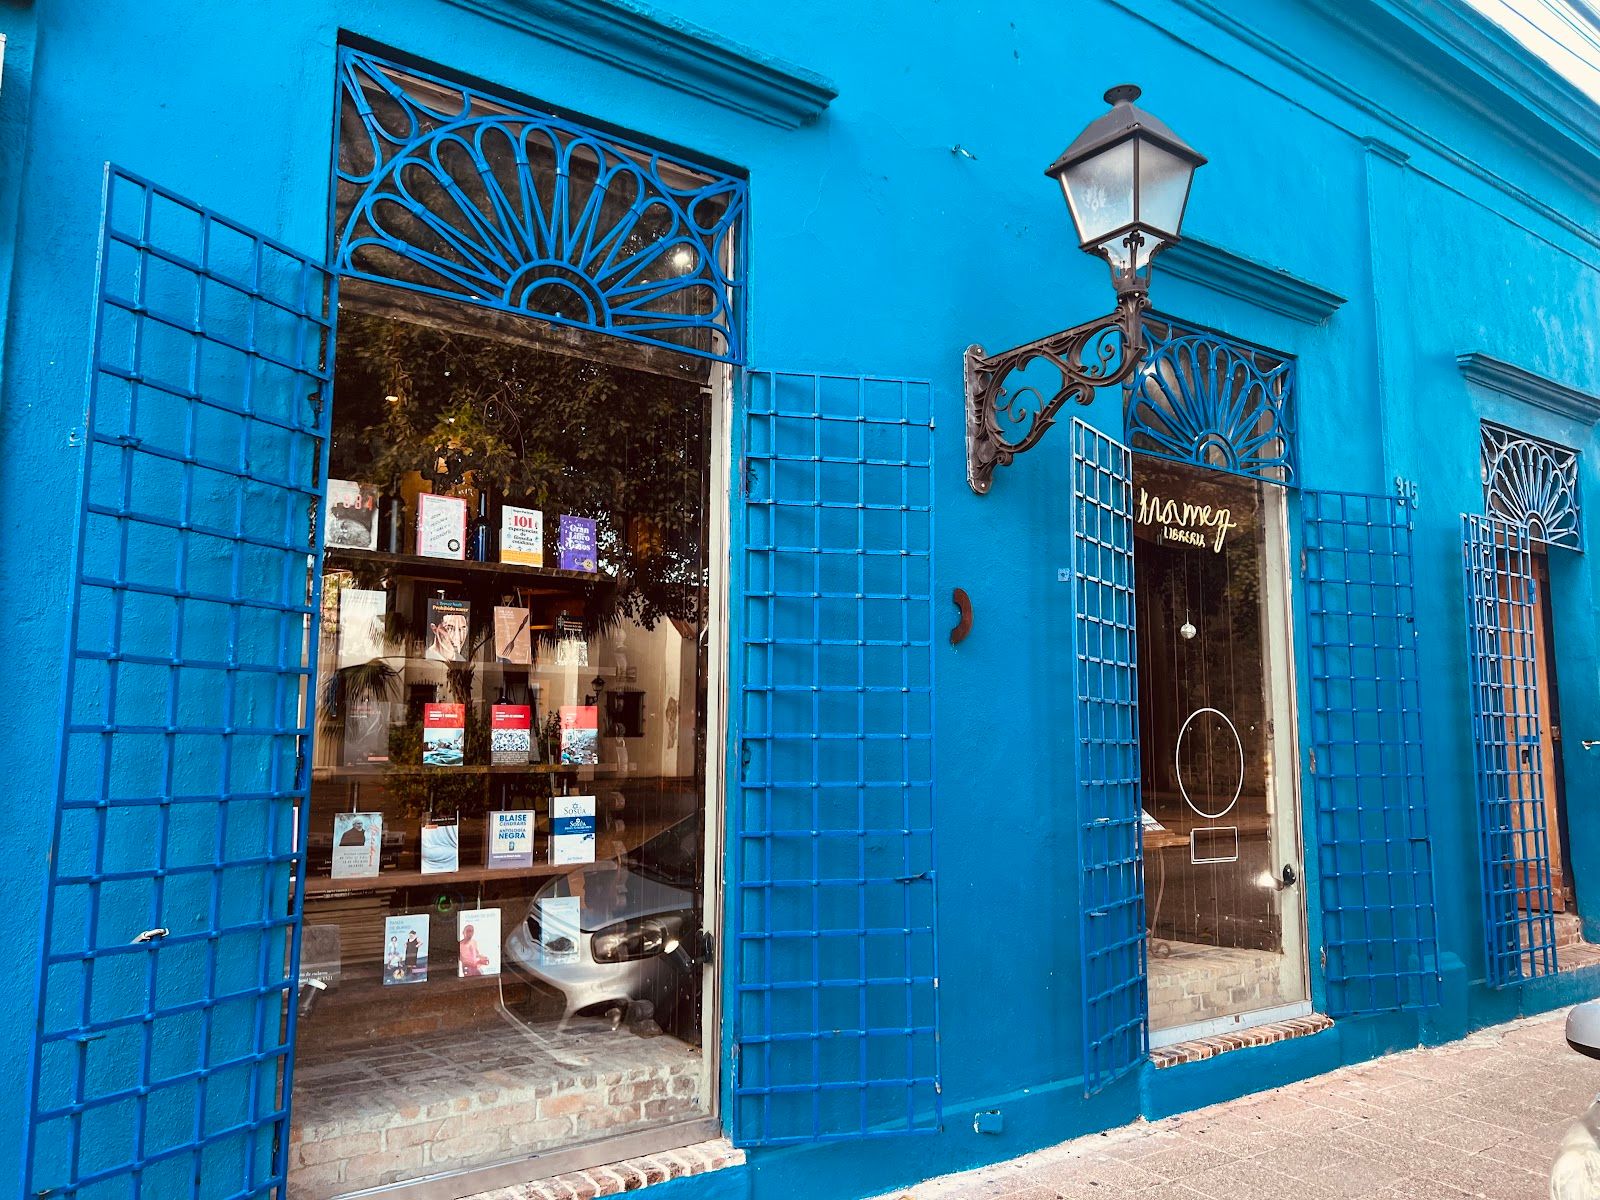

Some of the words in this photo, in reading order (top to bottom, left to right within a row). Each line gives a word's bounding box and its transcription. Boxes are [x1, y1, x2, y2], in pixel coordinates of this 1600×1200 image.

[1396, 476, 1419, 509] 315
[514, 515, 533, 528] 101
[570, 524, 589, 534] Gran
[499, 814, 527, 822] BLAISE
